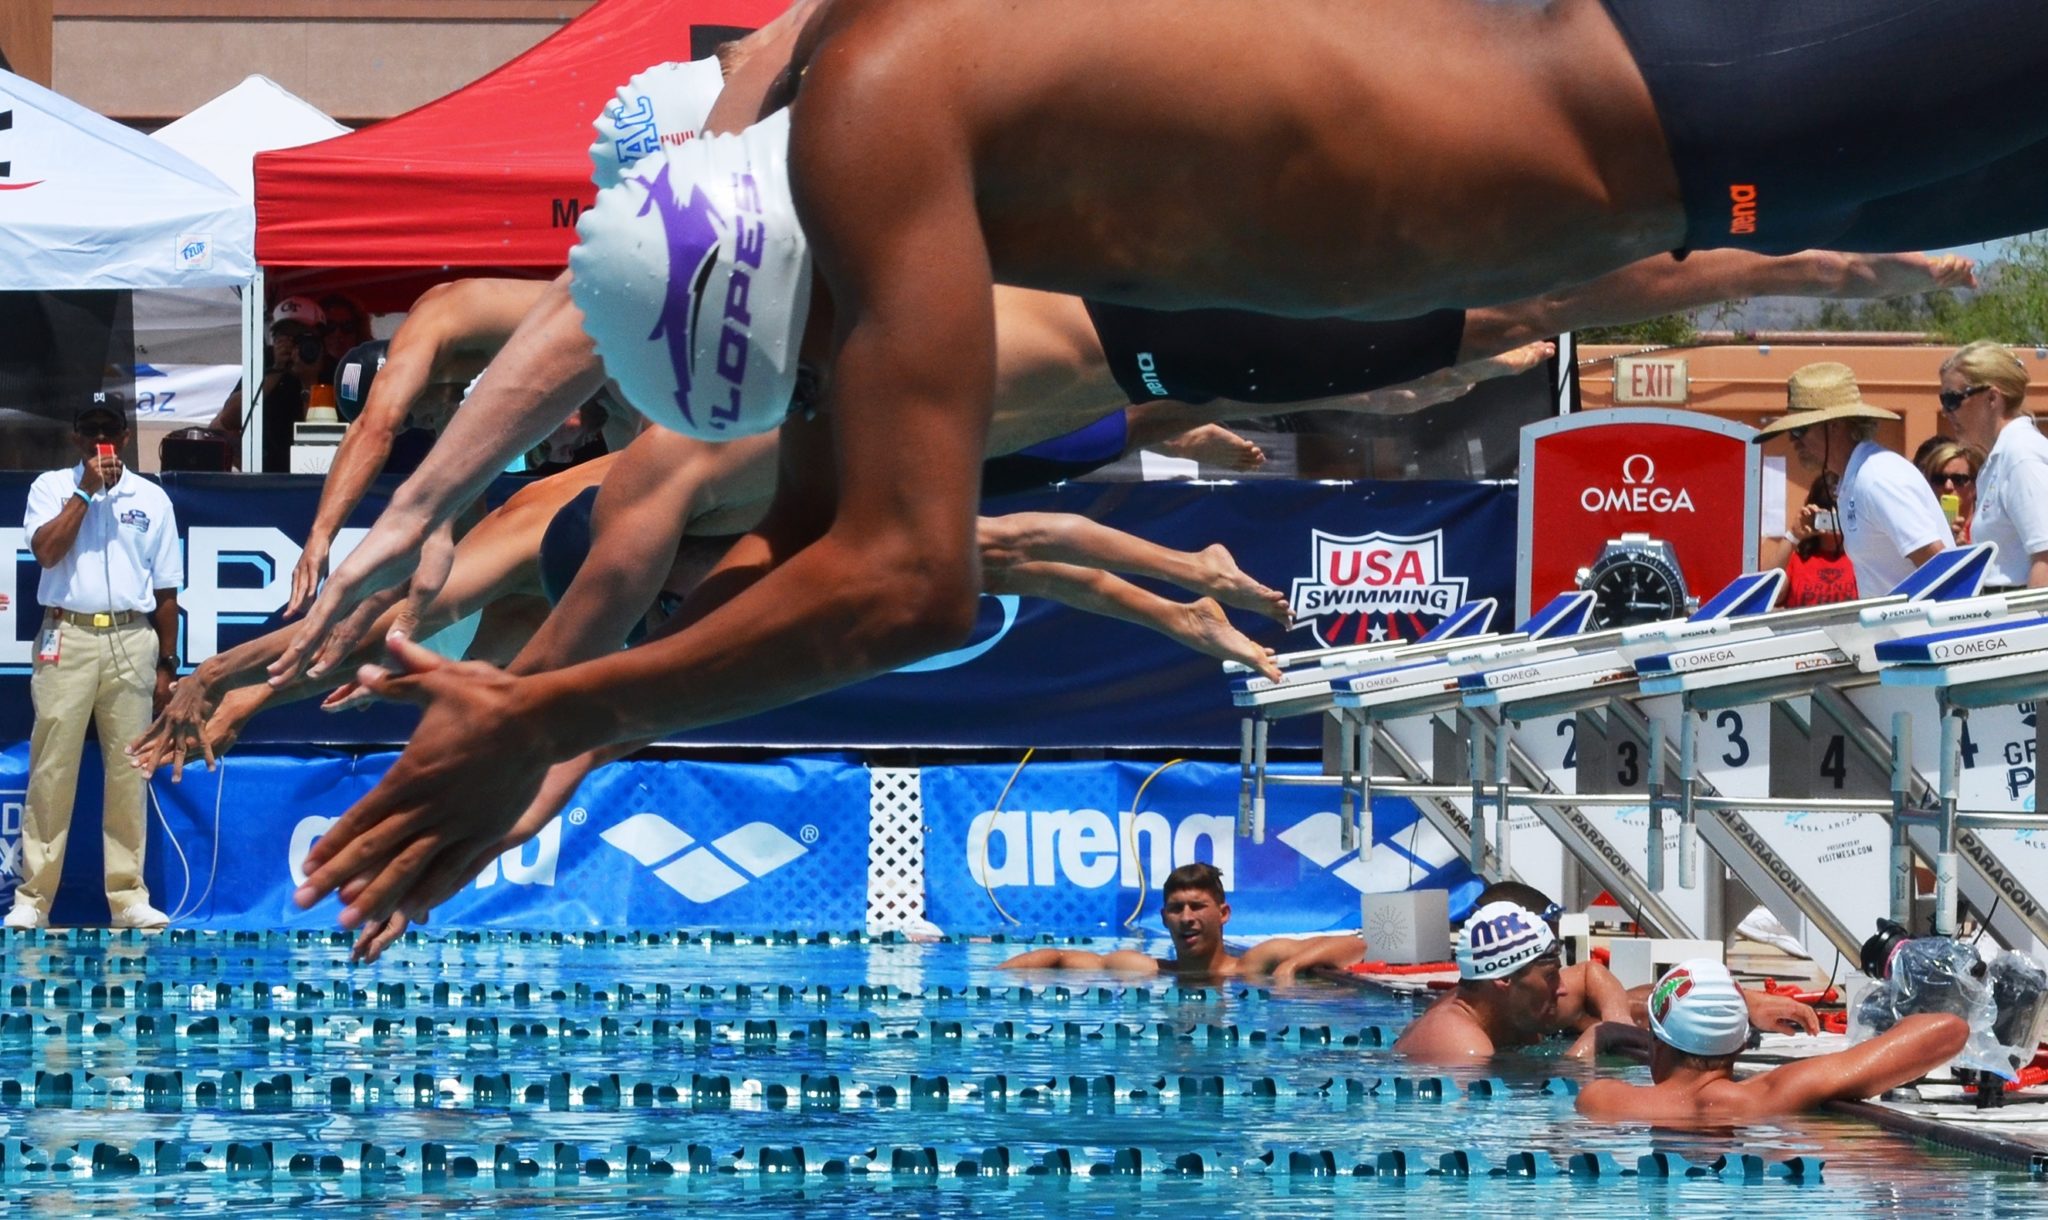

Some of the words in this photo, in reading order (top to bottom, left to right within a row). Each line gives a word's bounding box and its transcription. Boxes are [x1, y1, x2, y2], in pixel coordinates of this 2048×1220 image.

[1631, 364, 1675, 397] EXIT
[1581, 487, 1696, 513] OMEGA
[1329, 549, 1426, 587] USA
[1305, 589, 1449, 611] SWIMMING
[1889, 607, 1921, 617] PENTAIR
[1689, 650, 1736, 666] OMEGA
[1953, 637, 2008, 656] OMEGA
[1366, 676, 1399, 688] OMEGA
[1501, 667, 1542, 684] OMEGA
[1556, 718, 1577, 769] 2
[1716, 709, 1750, 768] 3
[1617, 741, 1640, 787] 3
[1820, 734, 1846, 789] 4
[966, 808, 1236, 893] arena
[1571, 814, 1631, 876] PARAGON
[1735, 823, 1802, 894] PARAGON
[1817, 844, 1873, 864] VISITMESA.COM
[1957, 832, 2037, 917] PARAGON
[1474, 943, 1544, 975] LOCHTE
